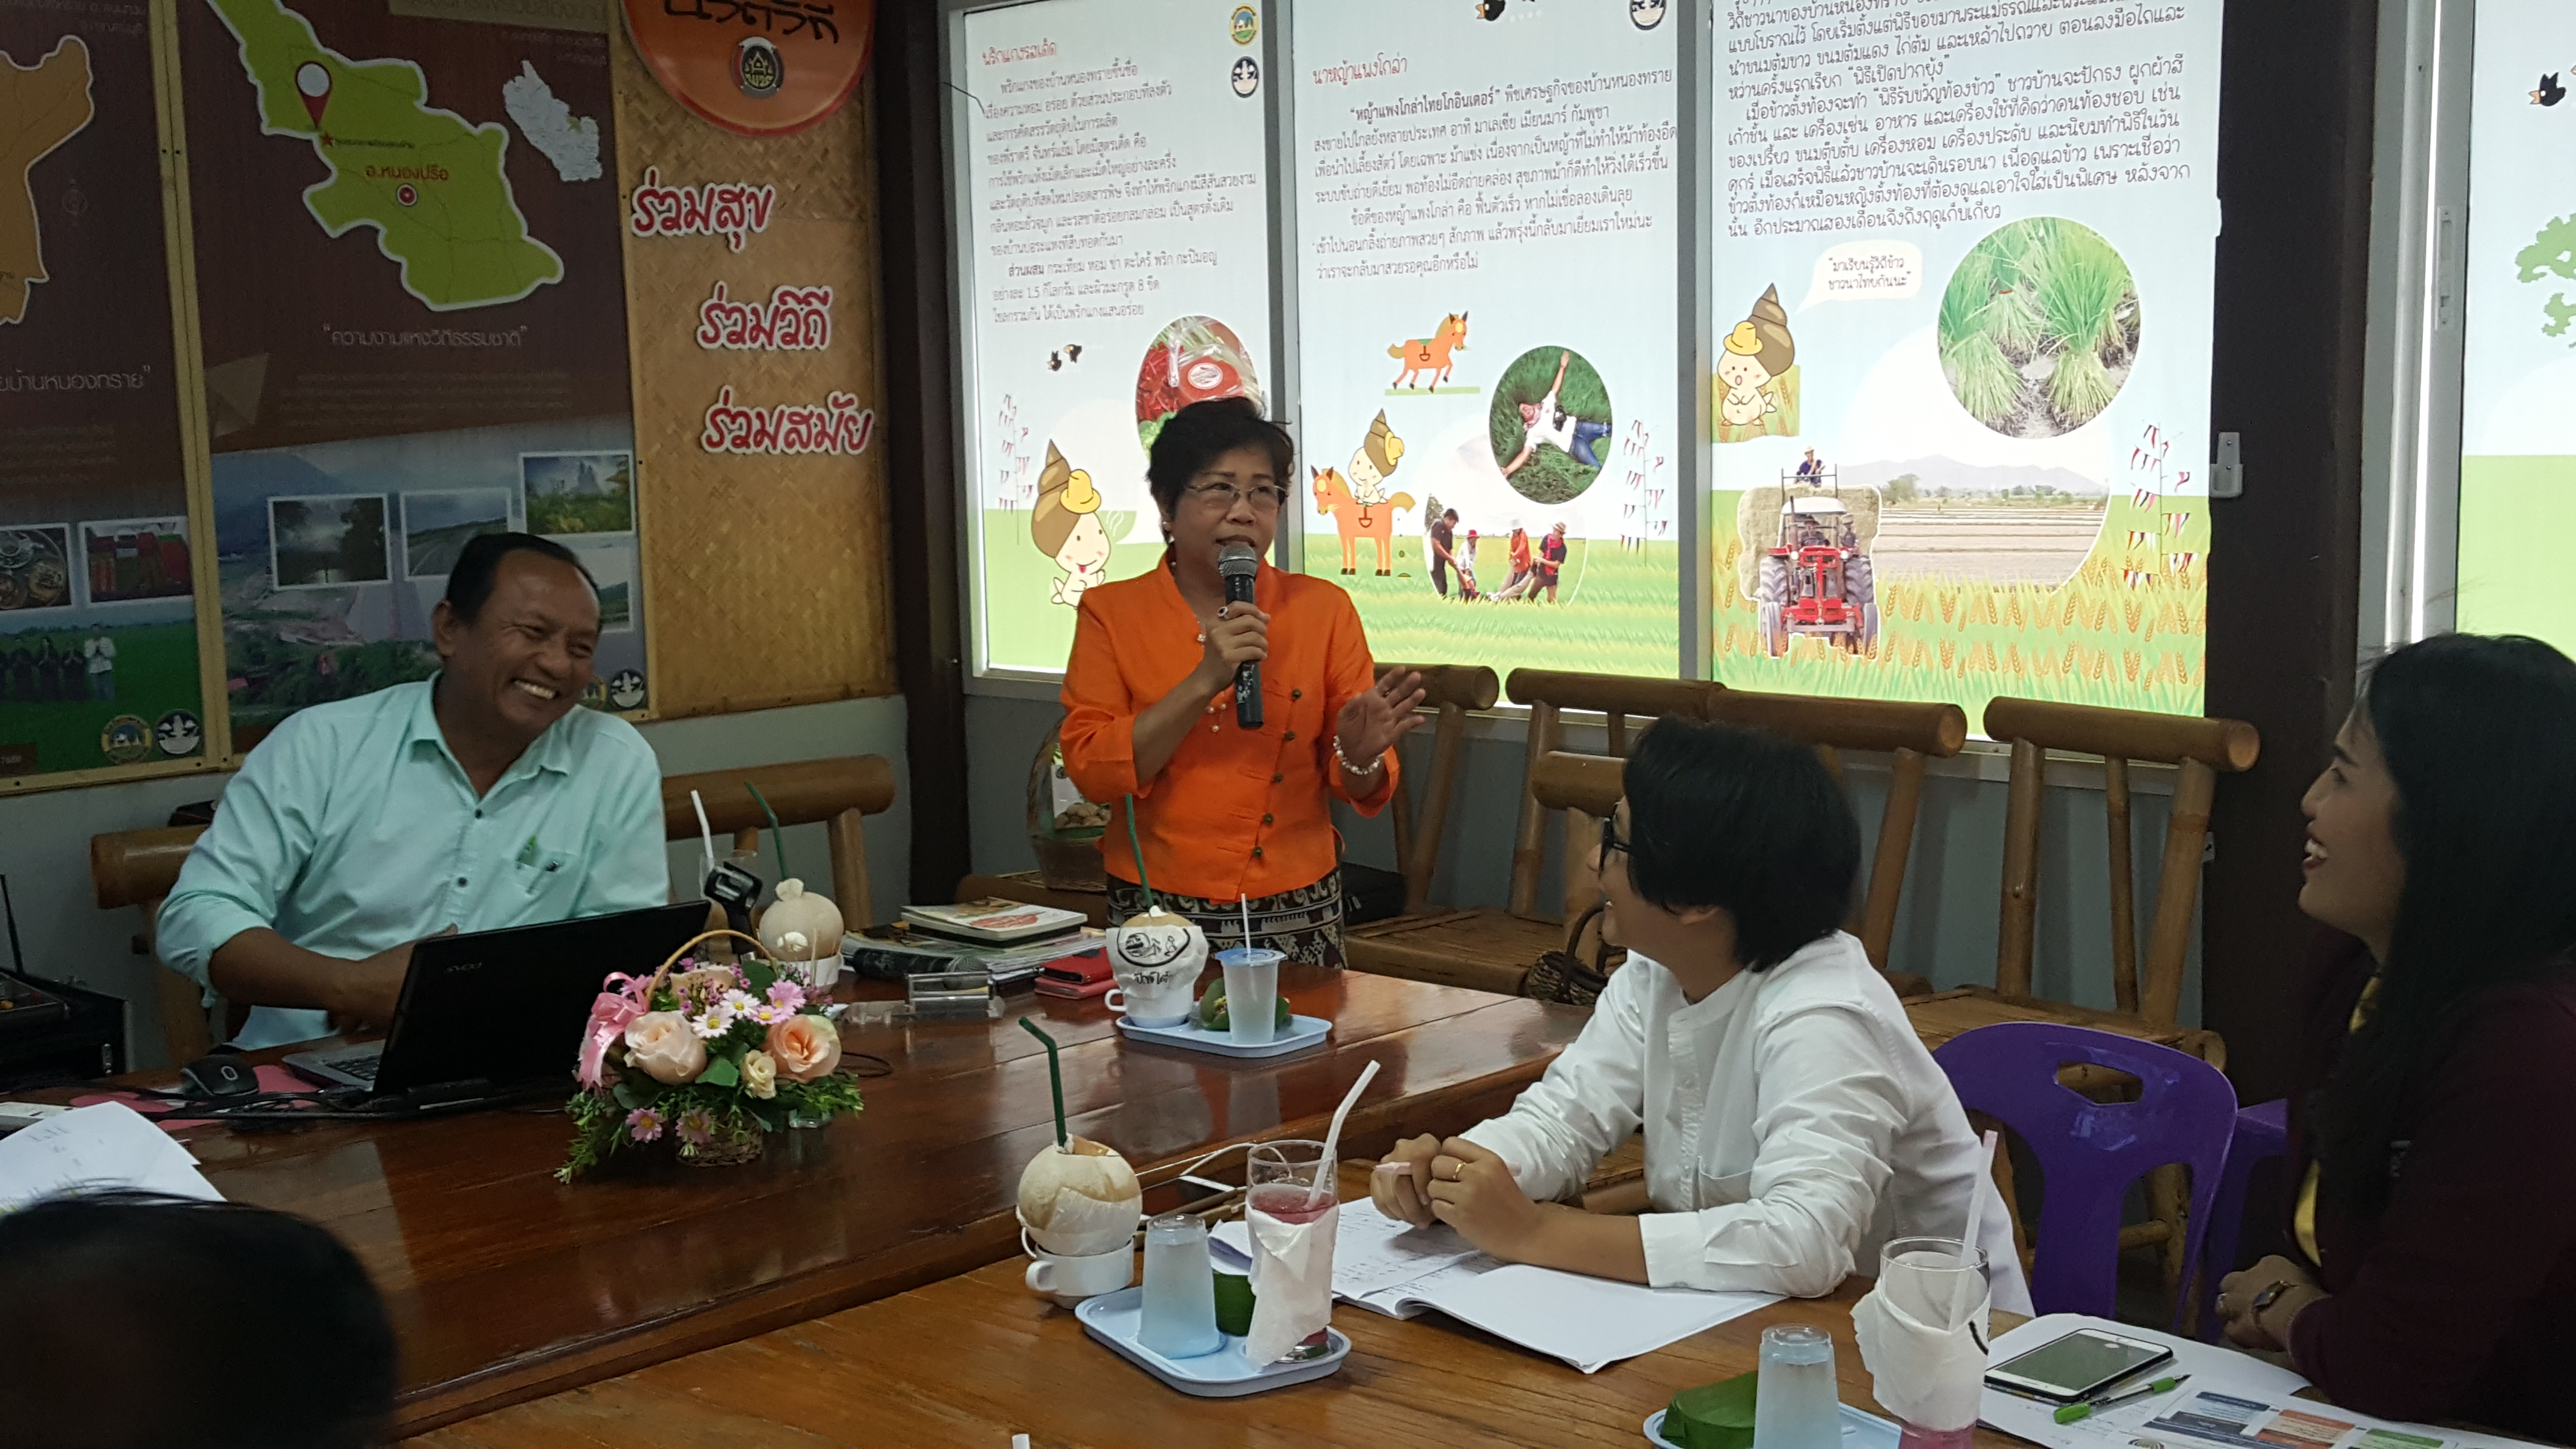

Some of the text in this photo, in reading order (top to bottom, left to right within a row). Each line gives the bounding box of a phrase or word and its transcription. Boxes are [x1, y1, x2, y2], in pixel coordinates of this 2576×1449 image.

[1894, 33, 1932, 56] ไก่ต้ม
[2129, 53, 2184, 85] ผูกผ้าสี
[1772, 118, 1800, 141] และ
[1875, 113, 1918, 131] อาหาร
[2151, 81, 2181, 102] เช่น
[1864, 129, 1937, 156] เครื่องหอม
[1941, 122, 2033, 148] เครื่องประดับ
[1728, 171, 1756, 197] ศุกร์
[2003, 139, 2088, 168] เพื่อดูแลข้าว
[2094, 132, 2180, 161] เพราะเชื่อว่า
[2124, 161, 2190, 183] หลังจาก
[633, 168, 774, 250] ร่วมสุข
[1457, 197, 1472, 216] คือ
[1449, 222, 1484, 244] สักภาพ
[1728, 217, 1748, 237] นั้น
[1154, 251, 1174, 266] พริก
[1136, 275, 1144, 291] 8
[699, 285, 831, 347] ร่วมวิถี
[705, 389, 872, 452] ร่วมสมัย
